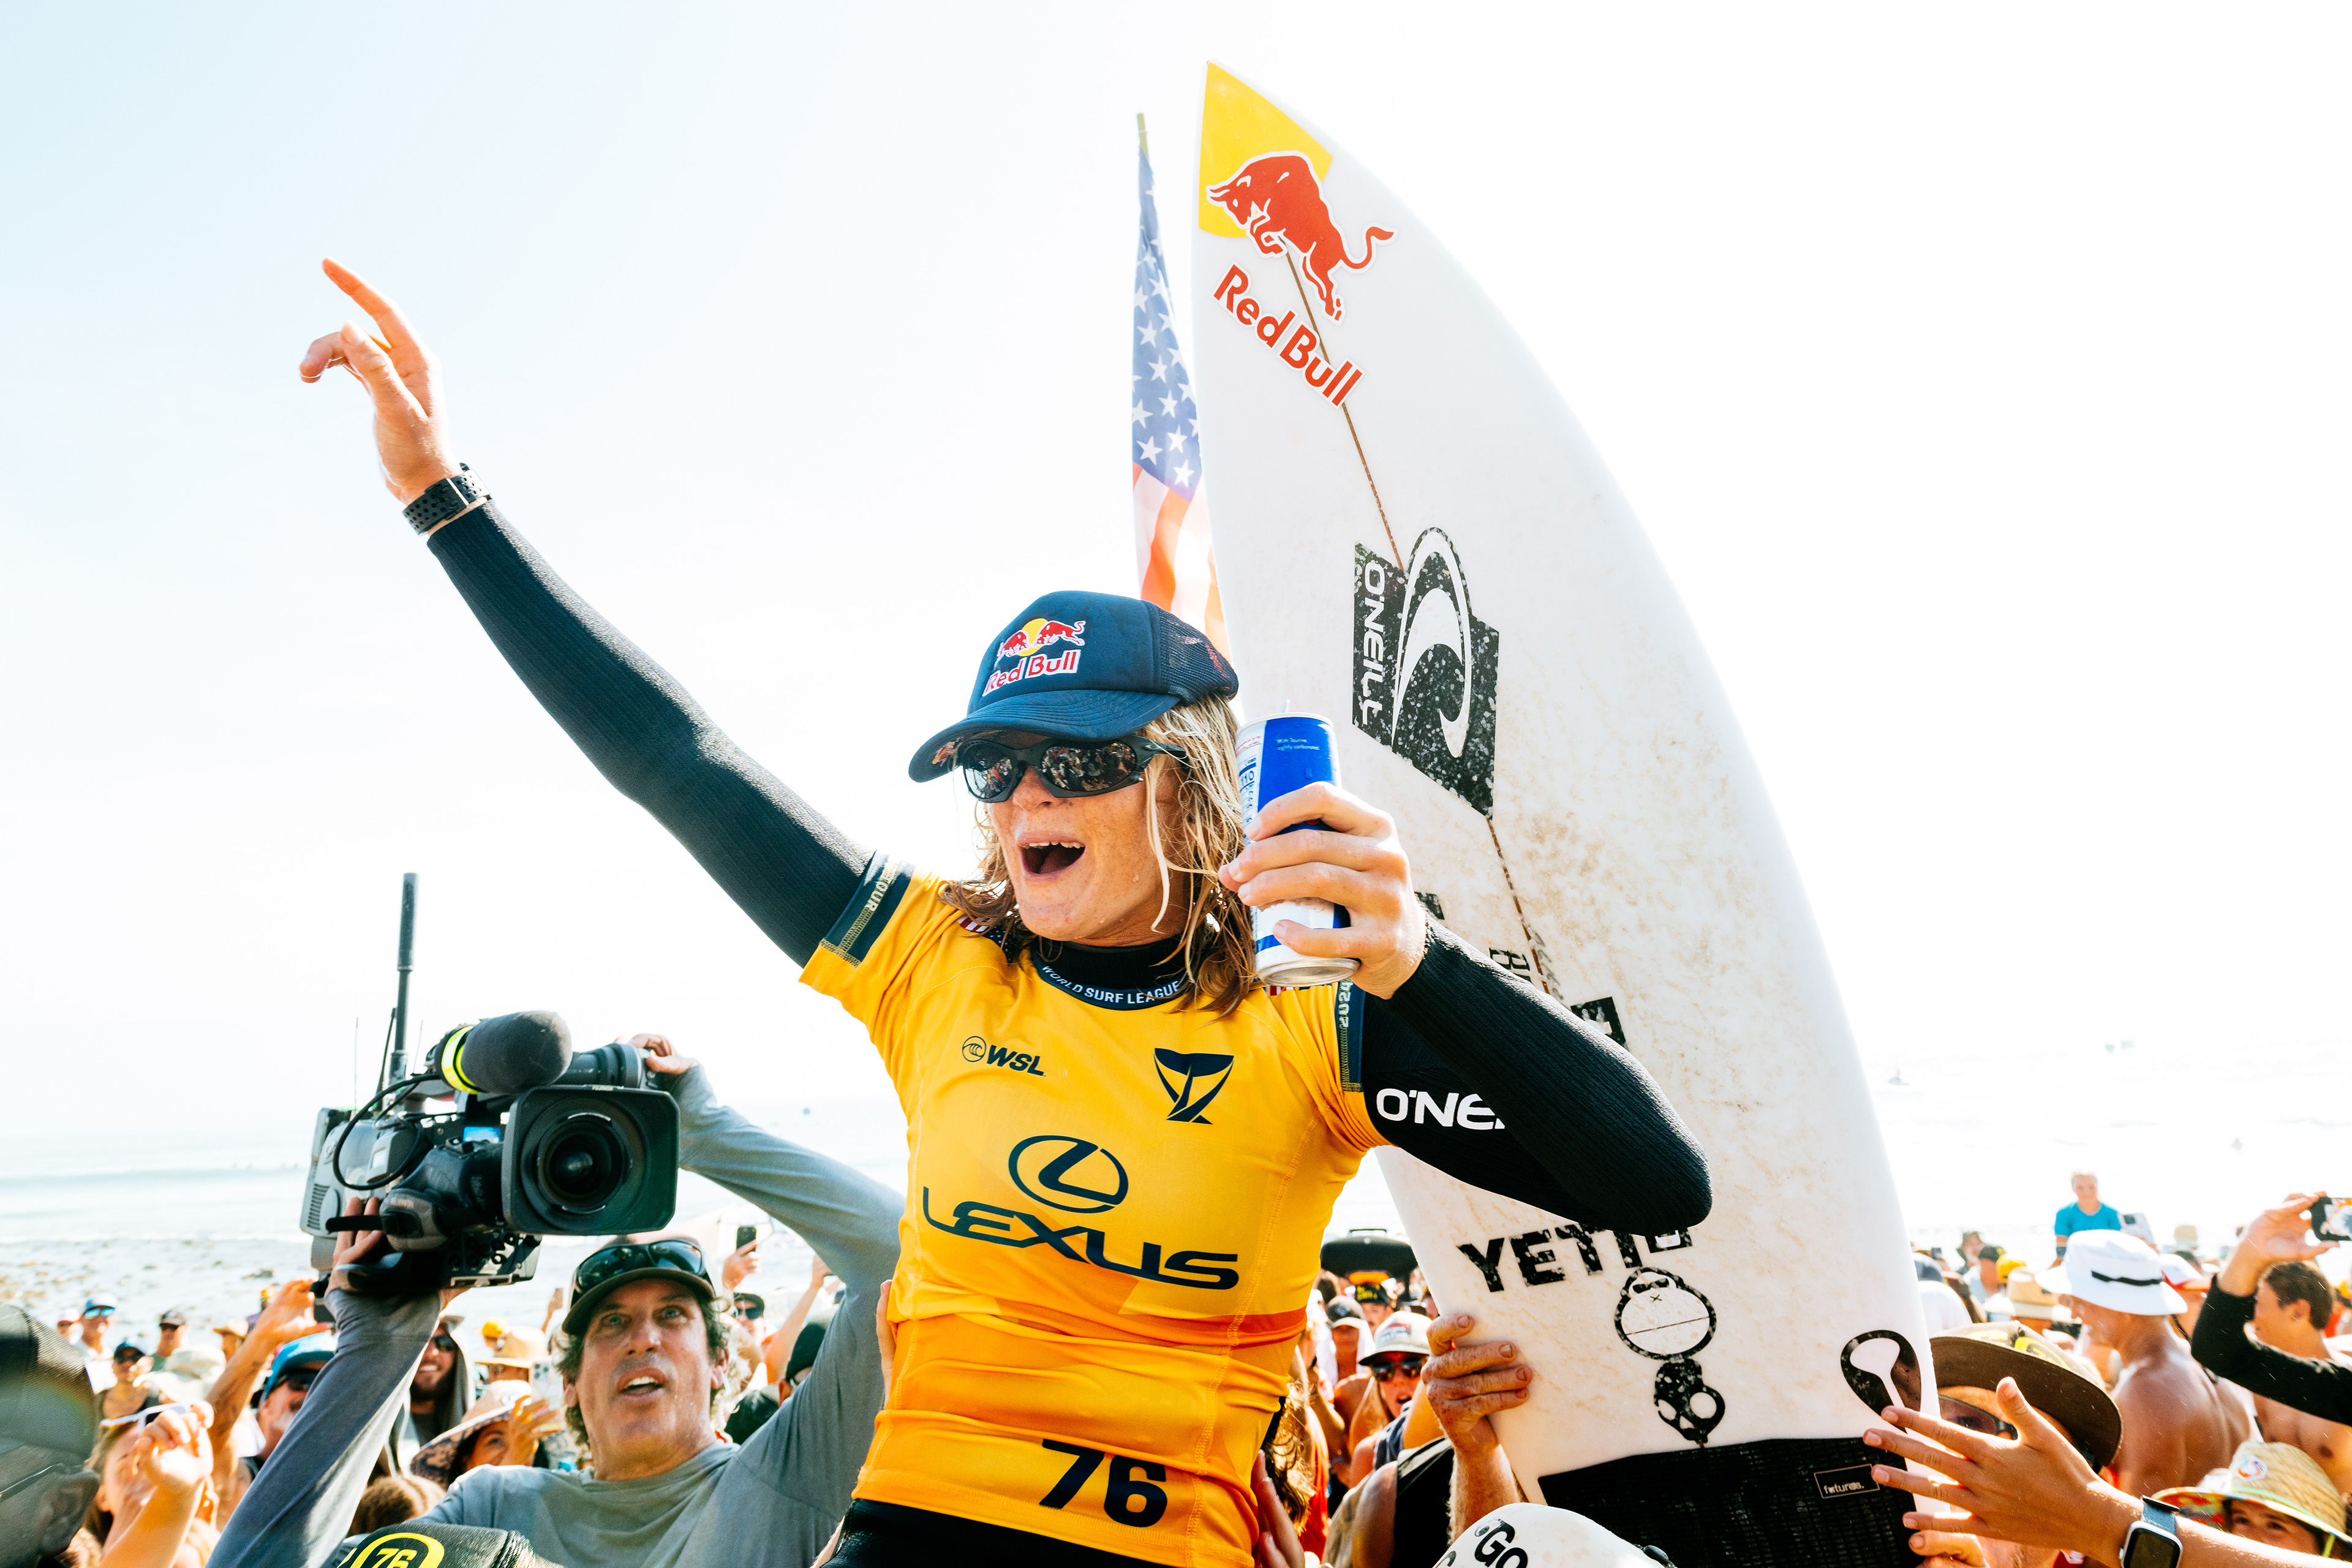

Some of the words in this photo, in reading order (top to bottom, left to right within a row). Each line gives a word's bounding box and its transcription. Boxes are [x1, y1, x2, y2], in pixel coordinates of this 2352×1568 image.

[1213, 264, 1296, 349] Red
[1279, 324, 1363, 407] Bull
[984, 658, 1025, 694] Red
[1027, 650, 1079, 677] Bull
[1042, 966, 1083, 992] WORLD
[1084, 987, 1123, 1003] SURF
[1127, 980, 1180, 1004] LEAGUE
[987, 1044, 1045, 1076] WSL
[923, 1186, 1239, 1290] LEXUS
[1456, 1223, 1643, 1292] YETI
[1039, 1439, 1167, 1528] 76
[372, 1548, 418, 1568] 76
